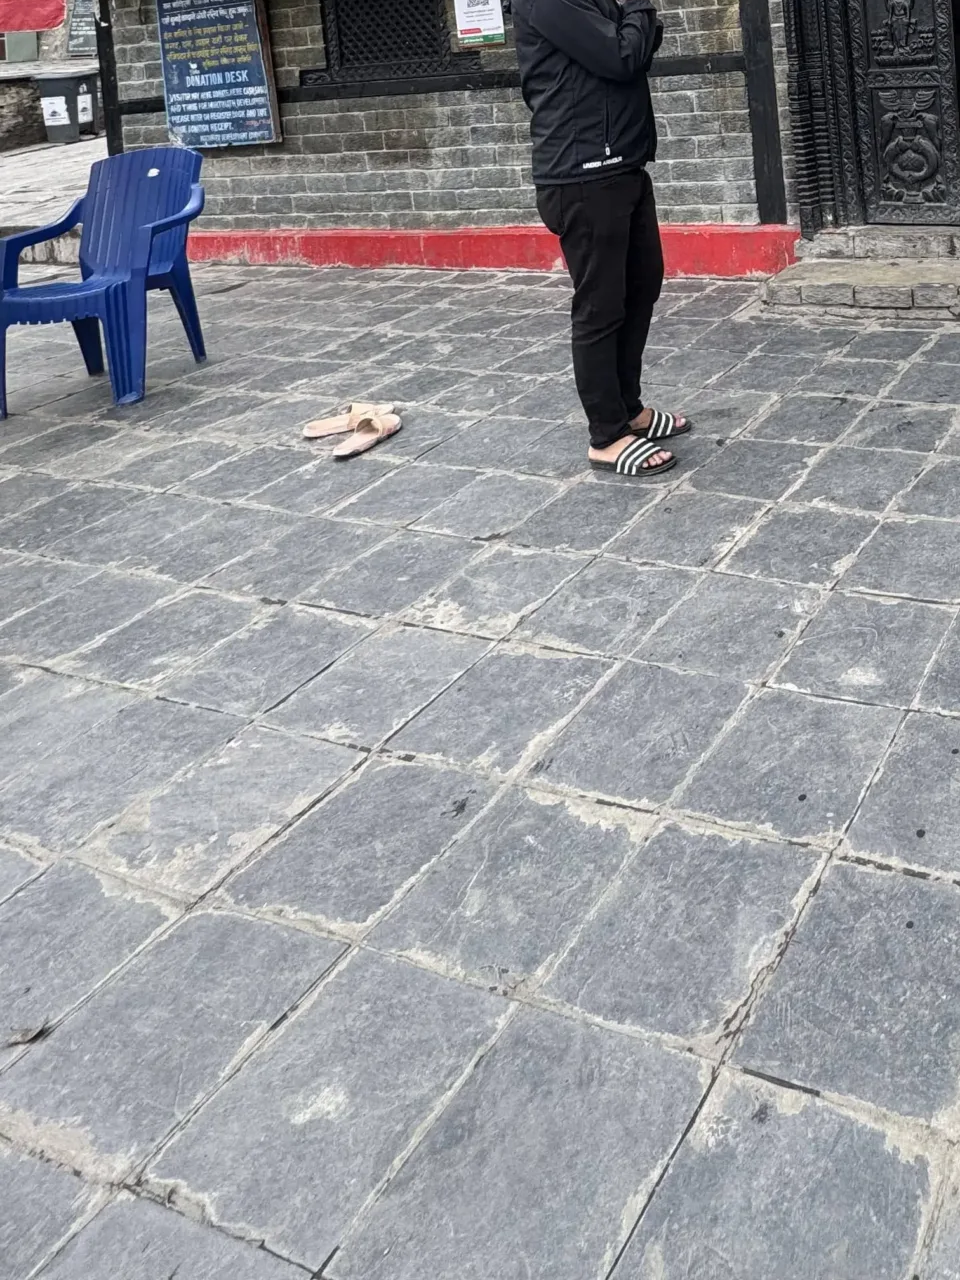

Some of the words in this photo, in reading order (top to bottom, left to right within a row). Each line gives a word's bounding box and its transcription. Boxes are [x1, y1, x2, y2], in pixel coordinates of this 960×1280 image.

[186, 73, 223, 87] DONATION
[225, 70, 249, 83] DESK
[583, 161, 602, 169] UNDER
